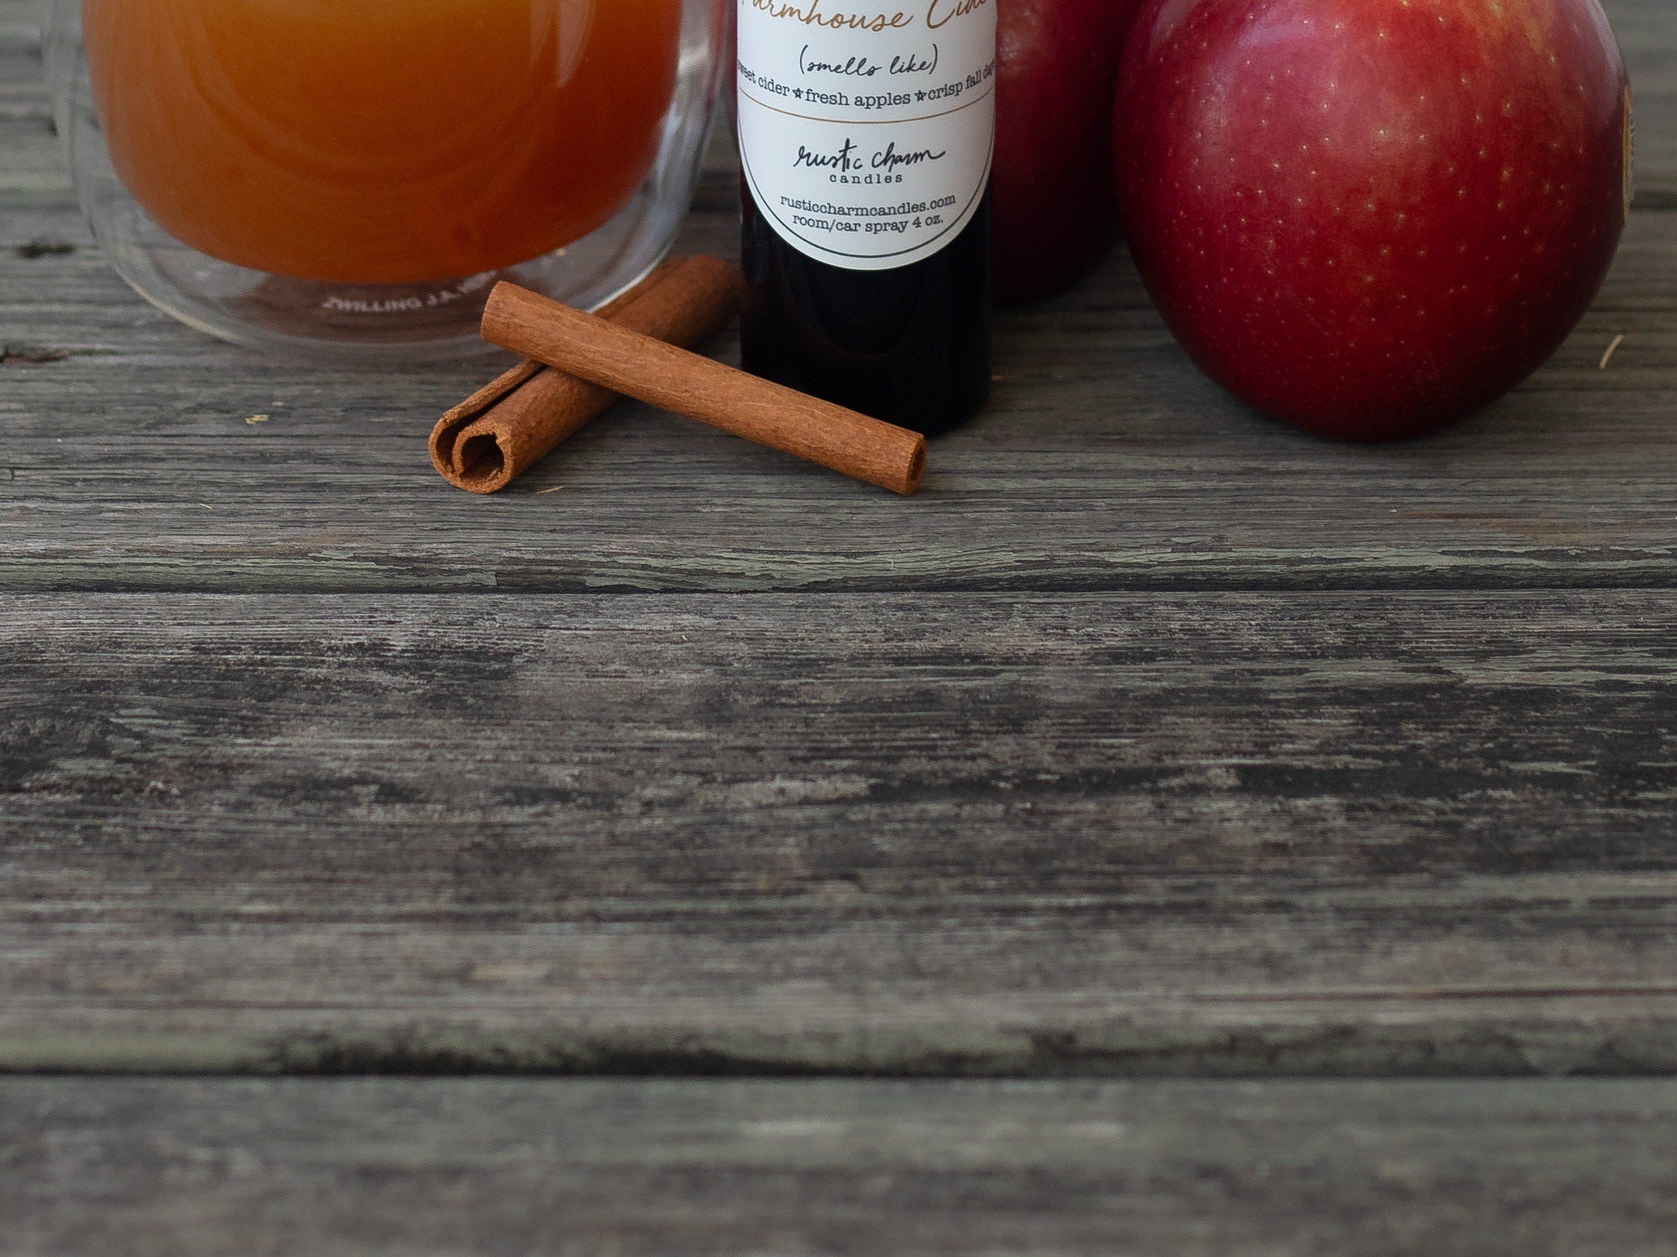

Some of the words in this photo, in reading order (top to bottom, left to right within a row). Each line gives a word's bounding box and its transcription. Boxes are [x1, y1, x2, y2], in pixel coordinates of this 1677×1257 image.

[799, 44, 883, 77] (smells
[889, 43, 939, 75] like)
[758, 76, 791, 97] cider
[804, 89, 850, 106] fresh
[854, 91, 911, 109] apples
[928, 80, 963, 101] crisp
[965, 69, 982, 90] fall
[793, 137, 863, 173] rustic
[871, 142, 946, 173] charm
[829, 173, 903, 185] candles
[780, 193, 957, 218] rusticcharmcandles.com
[792, 212, 862, 234] room/car
[864, 219, 910, 235] spray
[911, 217, 922, 229] 4
[925, 214, 944, 227] oz.
